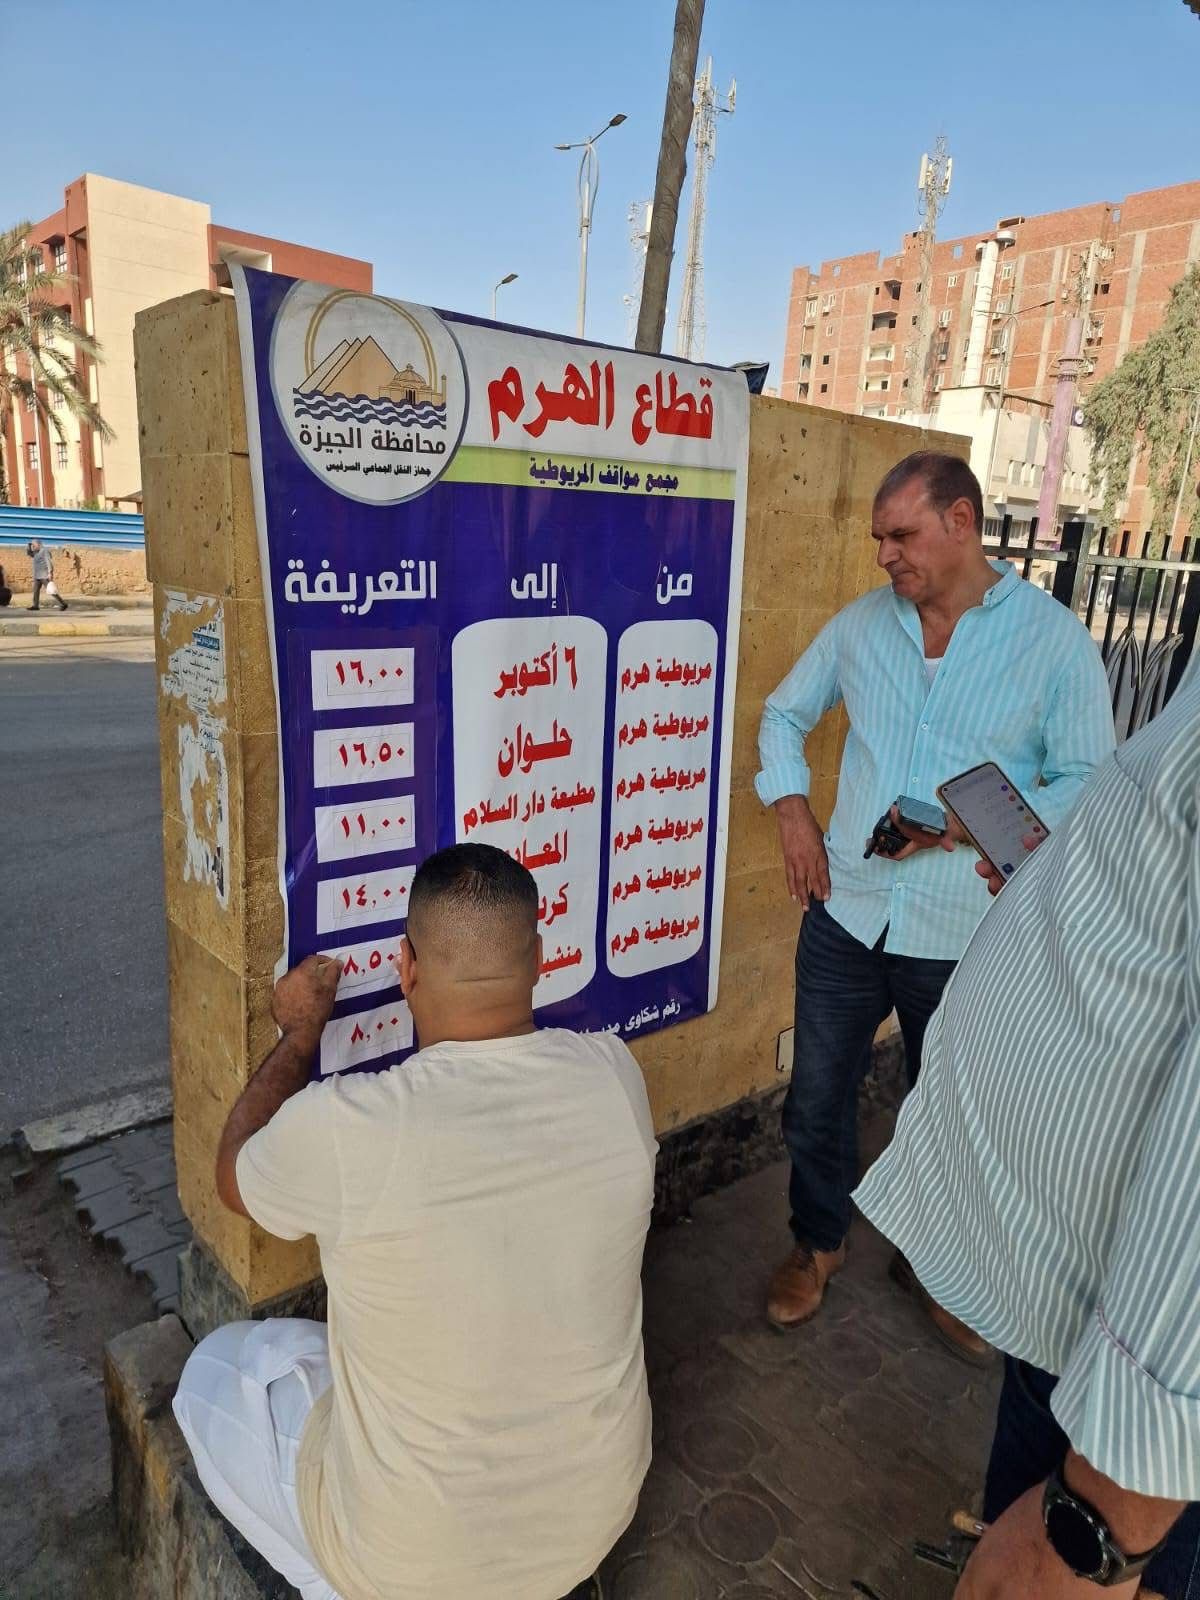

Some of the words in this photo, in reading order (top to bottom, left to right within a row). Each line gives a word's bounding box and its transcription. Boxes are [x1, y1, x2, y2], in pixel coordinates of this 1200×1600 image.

[487, 359, 616, 442] الهرم
[632, 369, 714, 446] قطاع
[299, 423, 362, 456] الجيزة
[371, 428, 447, 455] محافظة
[529, 456, 595, 487] المريوطية
[598, 464, 640, 491] مواقف
[645, 472, 679, 493] مجمع
[284, 559, 437, 616] التعريفة
[510, 562, 558, 609] إلى
[656, 565, 693, 605] من
[493, 641, 558, 699] أكتوبر
[564, 645, 578, 690] ٦
[621, 661, 650, 694] هرم
[655, 656, 712, 688] مريوطية
[618, 717, 648, 749] هرم
[652, 711, 709, 742] مريوطية
[497, 719, 573, 778] حلوان
[616, 772, 645, 803] هرم
[649, 765, 706, 795] مريوطية
[521, 789, 545, 823] دار
[550, 781, 596, 813] مطبعة
[463, 793, 518, 835] السلام
[613, 824, 643, 855] هرم
[647, 816, 704, 845] مريوطية
[612, 873, 641, 905] هرم
[645, 863, 702, 894] مريوطية
[610, 926, 640, 957] هرم
[643, 914, 700, 945] مريوطية
[662, 998, 681, 1021] رقم
